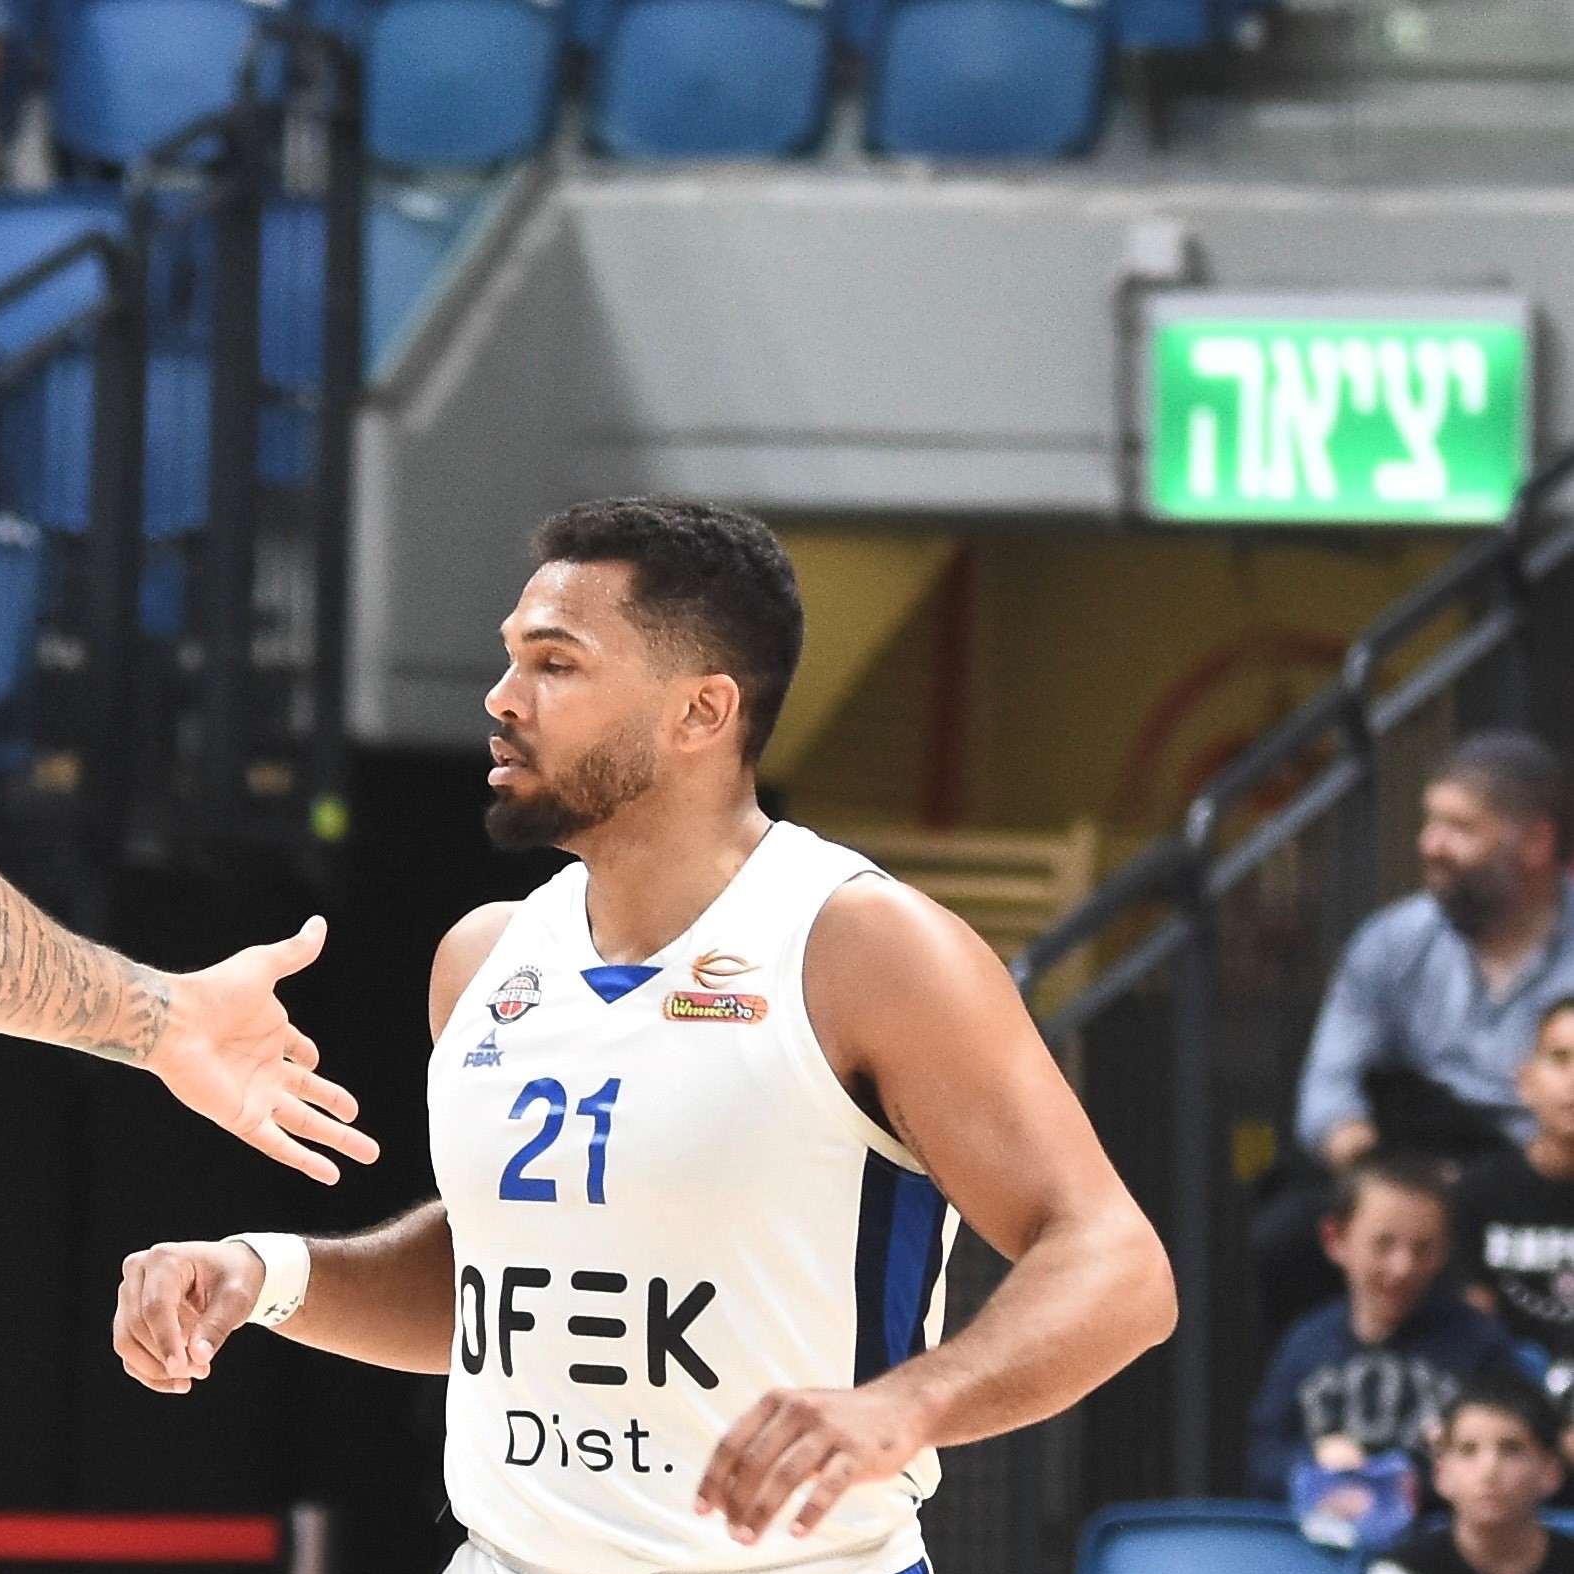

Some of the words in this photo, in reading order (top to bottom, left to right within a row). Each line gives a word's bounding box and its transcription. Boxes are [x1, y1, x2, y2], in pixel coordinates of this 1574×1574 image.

[1191, 338, 1486, 500] יציאה
[672, 998, 735, 1018] Winner
[499, 1077, 621, 1205] 21
[461, 1264, 720, 1390] OFEK
[505, 1410, 674, 1473] Dist.
